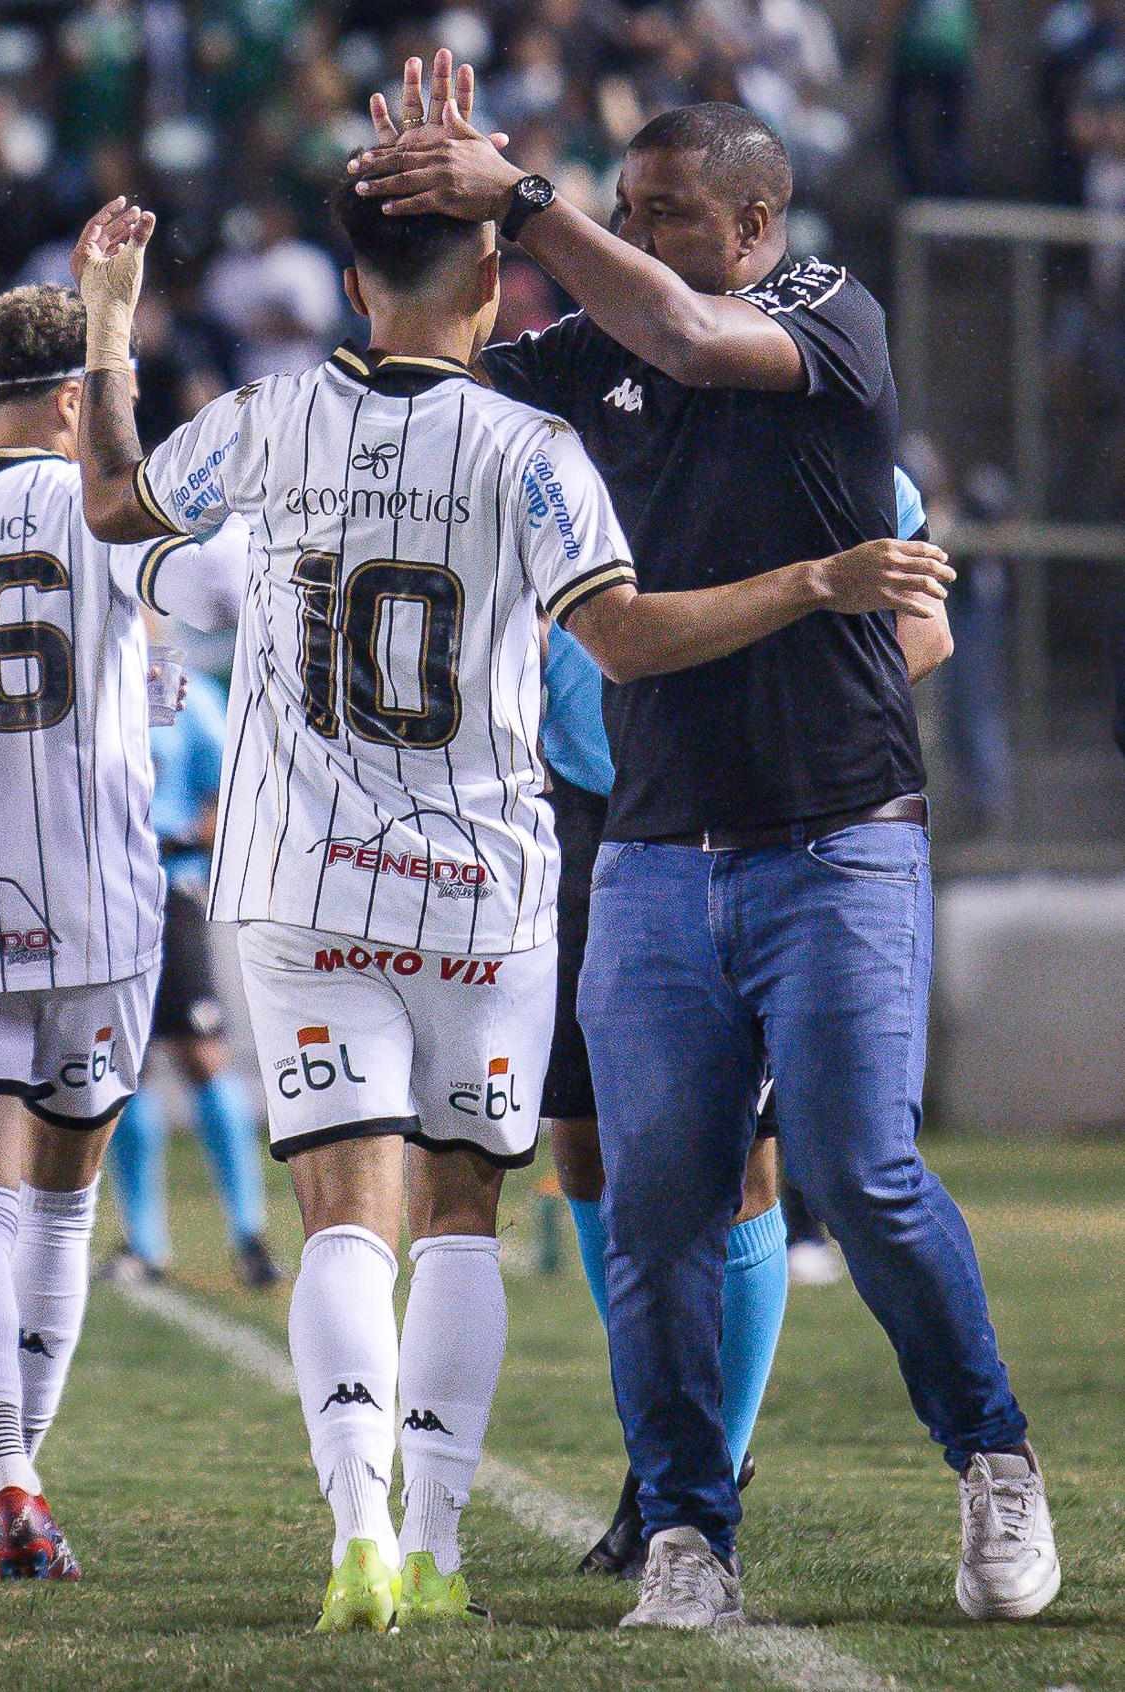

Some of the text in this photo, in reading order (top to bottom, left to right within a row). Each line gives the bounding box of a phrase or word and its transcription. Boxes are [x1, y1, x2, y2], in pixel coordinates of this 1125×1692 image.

[286, 486, 471, 524] ecosmetics
[545, 482, 581, 560] Bernardo
[288, 548, 466, 749] 10
[327, 842, 487, 886] PENEDO
[314, 945, 503, 986] MOTO VIX
[58, 1039, 117, 1089] cbl
[278, 1043, 367, 1100] cbl
[448, 1073, 521, 1121] cbl
